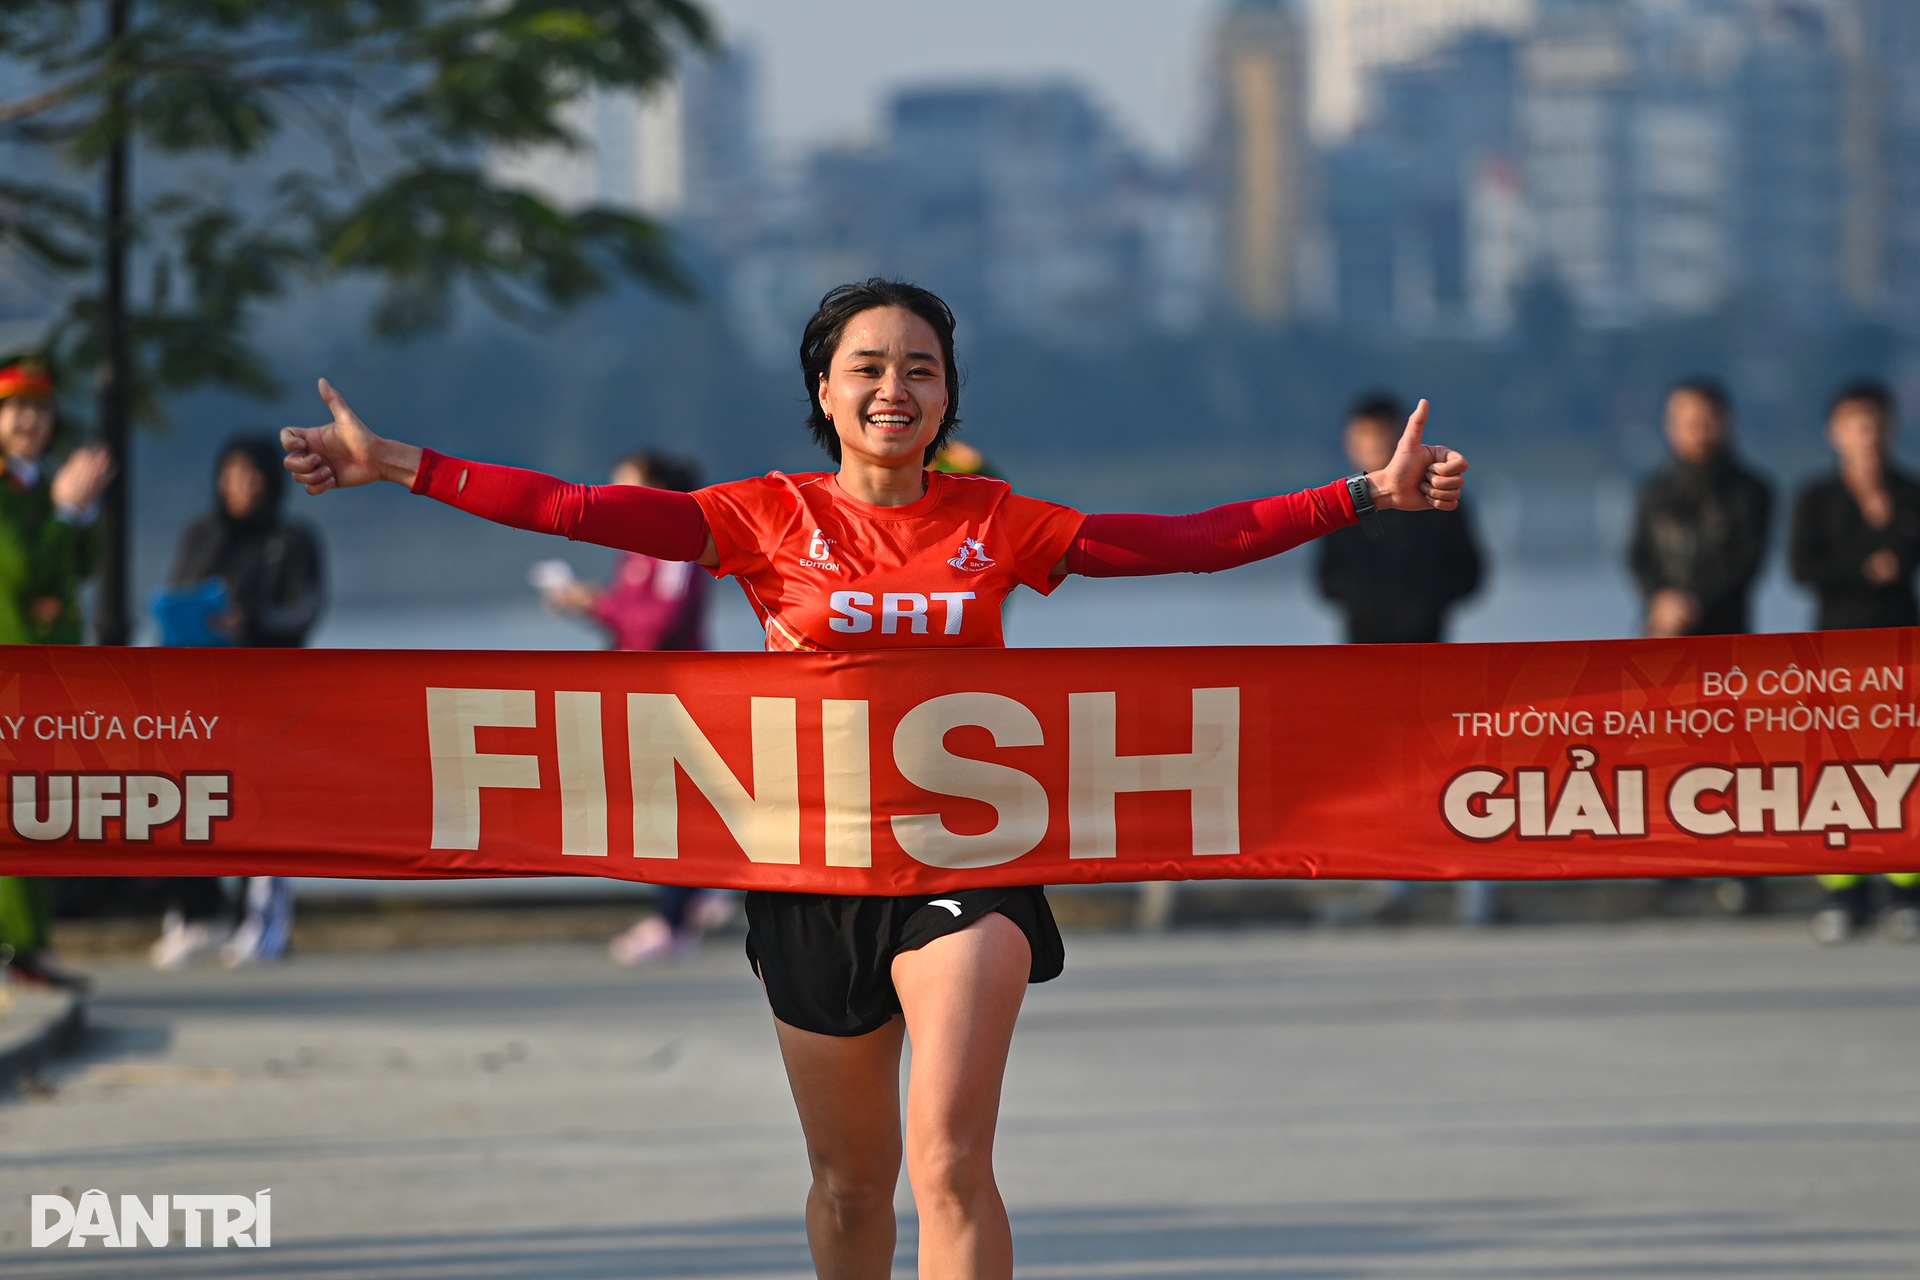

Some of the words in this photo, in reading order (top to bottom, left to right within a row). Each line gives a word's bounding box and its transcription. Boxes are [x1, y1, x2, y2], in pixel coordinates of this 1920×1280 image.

[800, 558, 840, 571] EDITION
[829, 591, 976, 635] SRT
[1703, 666, 1748, 700] BỘ
[1757, 663, 1852, 694] CÔNG
[1860, 666, 1904, 692] AN
[0, 715, 26, 740] Y
[34, 710, 127, 740] CHỮA
[133, 710, 219, 740] CHÁY
[1452, 705, 1595, 738] TRƯỜNG
[1603, 709, 1656, 740] ĐẠI
[1666, 706, 1736, 739] HỌC
[1745, 700, 1860, 732] PHÒNG
[1869, 702, 1920, 730] CH
[425, 686, 1241, 869] FINISH
[1443, 749, 1646, 839] GIẢI
[1669, 762, 1920, 846] CHẠY
[11, 774, 230, 841] UFPF
